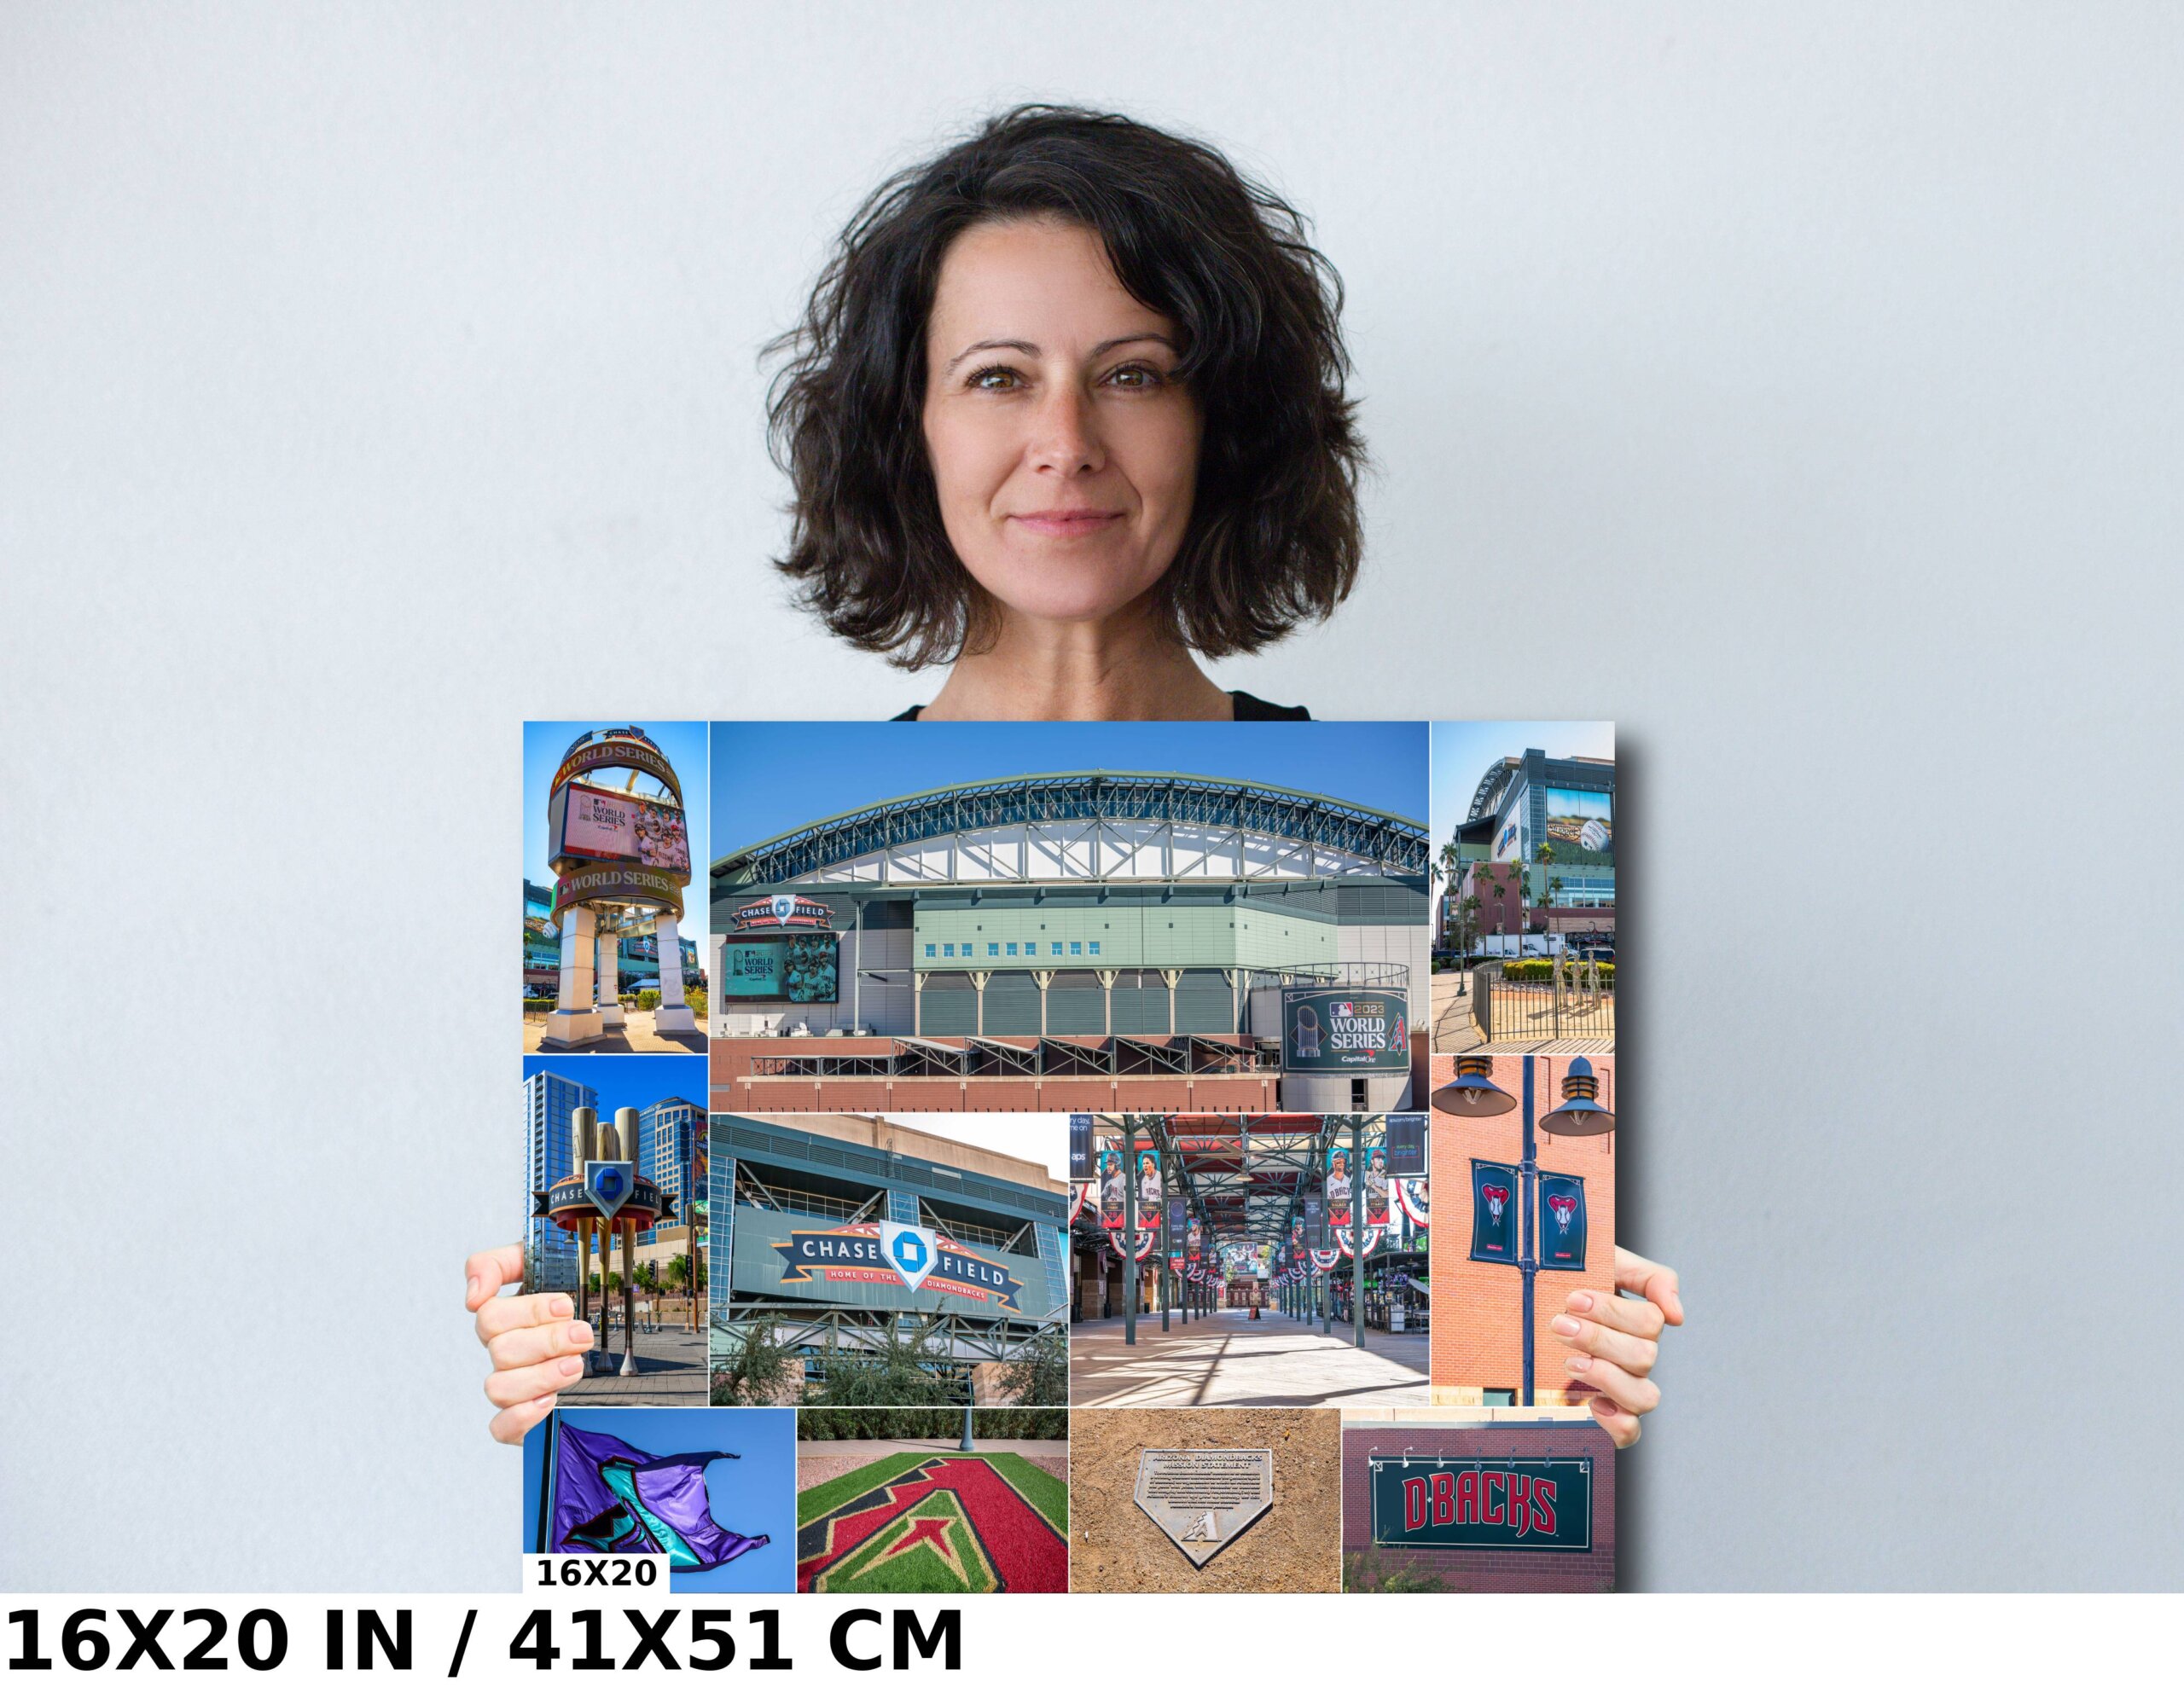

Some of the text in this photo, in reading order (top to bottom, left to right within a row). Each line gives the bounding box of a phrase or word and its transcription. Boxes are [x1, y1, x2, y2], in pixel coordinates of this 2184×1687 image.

[563, 745, 665, 775] WORLD SERIES
[593, 805, 625, 819] WORLD
[593, 813, 625, 826] SERIES
[572, 871, 621, 891] WORLD
[624, 871, 669, 891] SERIES
[741, 906, 824, 918] CHASE FIELD
[744, 958, 774, 966] WORLD
[744, 965, 774, 974] SERIES
[1354, 1005, 1385, 1014] 2023
[1329, 1017, 1385, 1033] WORLD
[1331, 1032, 1386, 1050] SERIES
[1071, 1153, 1086, 1162] aps
[550, 1188, 583, 1204] CHASE
[802, 1240, 1004, 1286] CHASE FIELD
[880, 1273, 897, 1282] THE
[927, 1280, 985, 1299] DIAMONDBACKS
